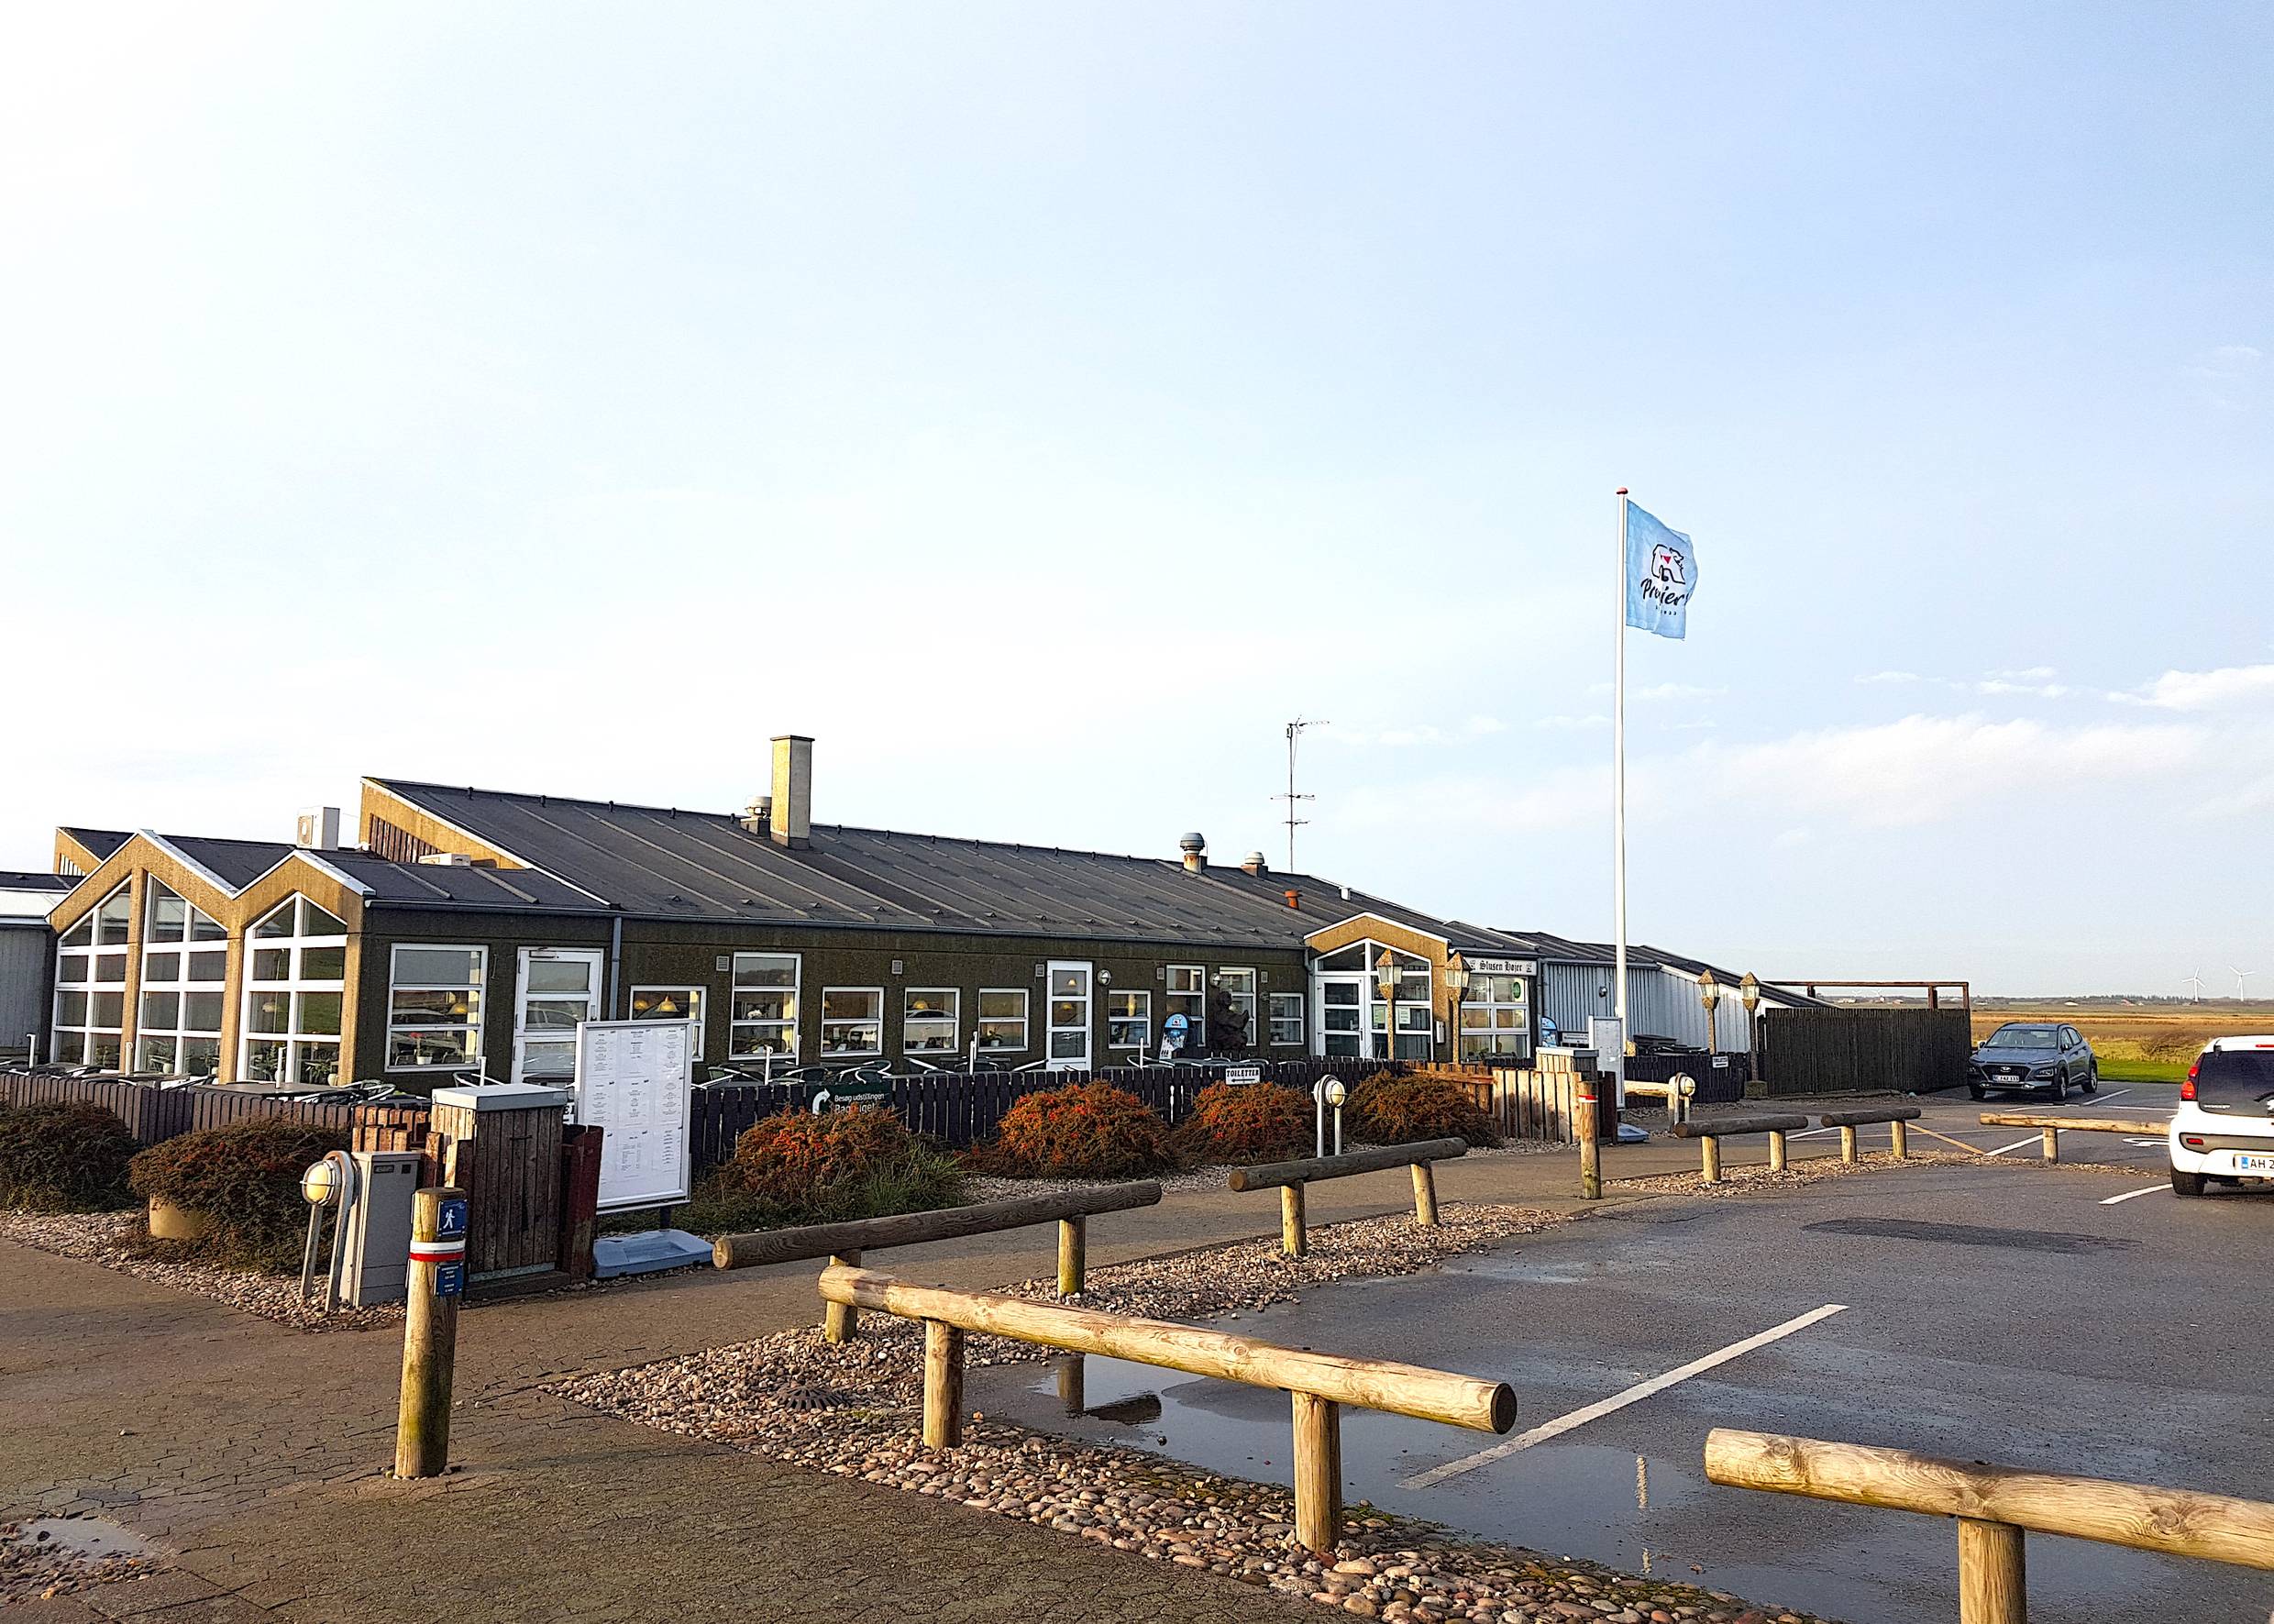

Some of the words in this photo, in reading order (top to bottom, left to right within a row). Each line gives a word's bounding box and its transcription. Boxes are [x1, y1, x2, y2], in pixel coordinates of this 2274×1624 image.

[1479, 960, 1503, 971] Slusen
[834, 1094, 853, 1103] Besøg
[2250, 1158, 2266, 1168] AH
